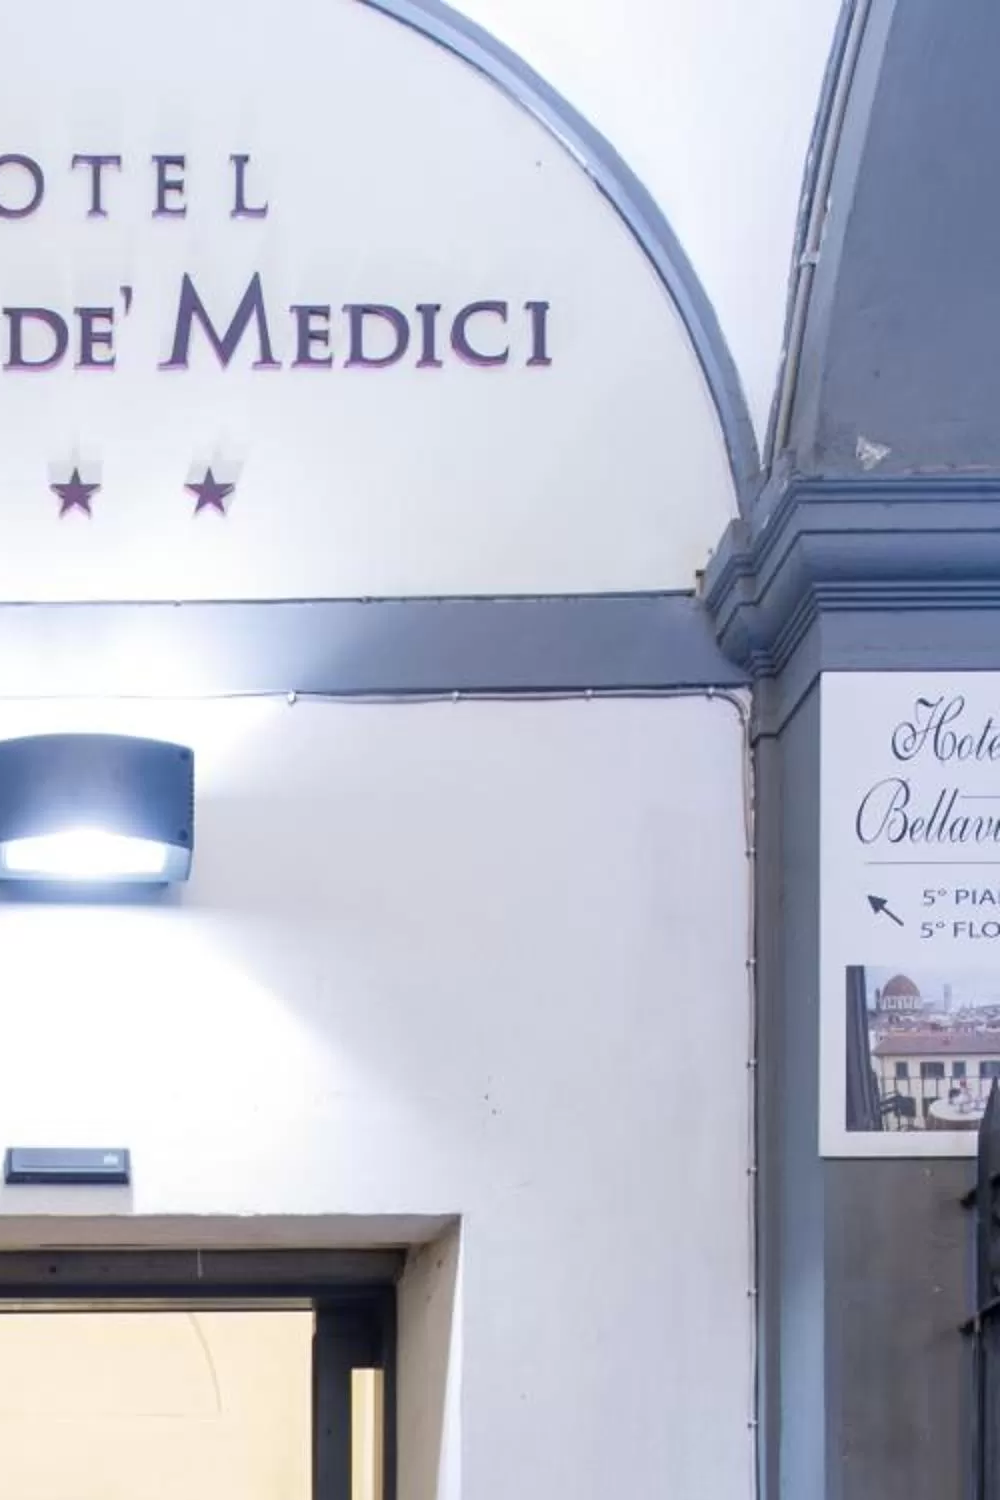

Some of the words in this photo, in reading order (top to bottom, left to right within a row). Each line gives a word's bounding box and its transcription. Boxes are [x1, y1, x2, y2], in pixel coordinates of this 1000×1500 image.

[3, 286, 133, 371] DE'
[157, 271, 553, 371] MEDICI
[955, 889, 1000, 905] PIA
